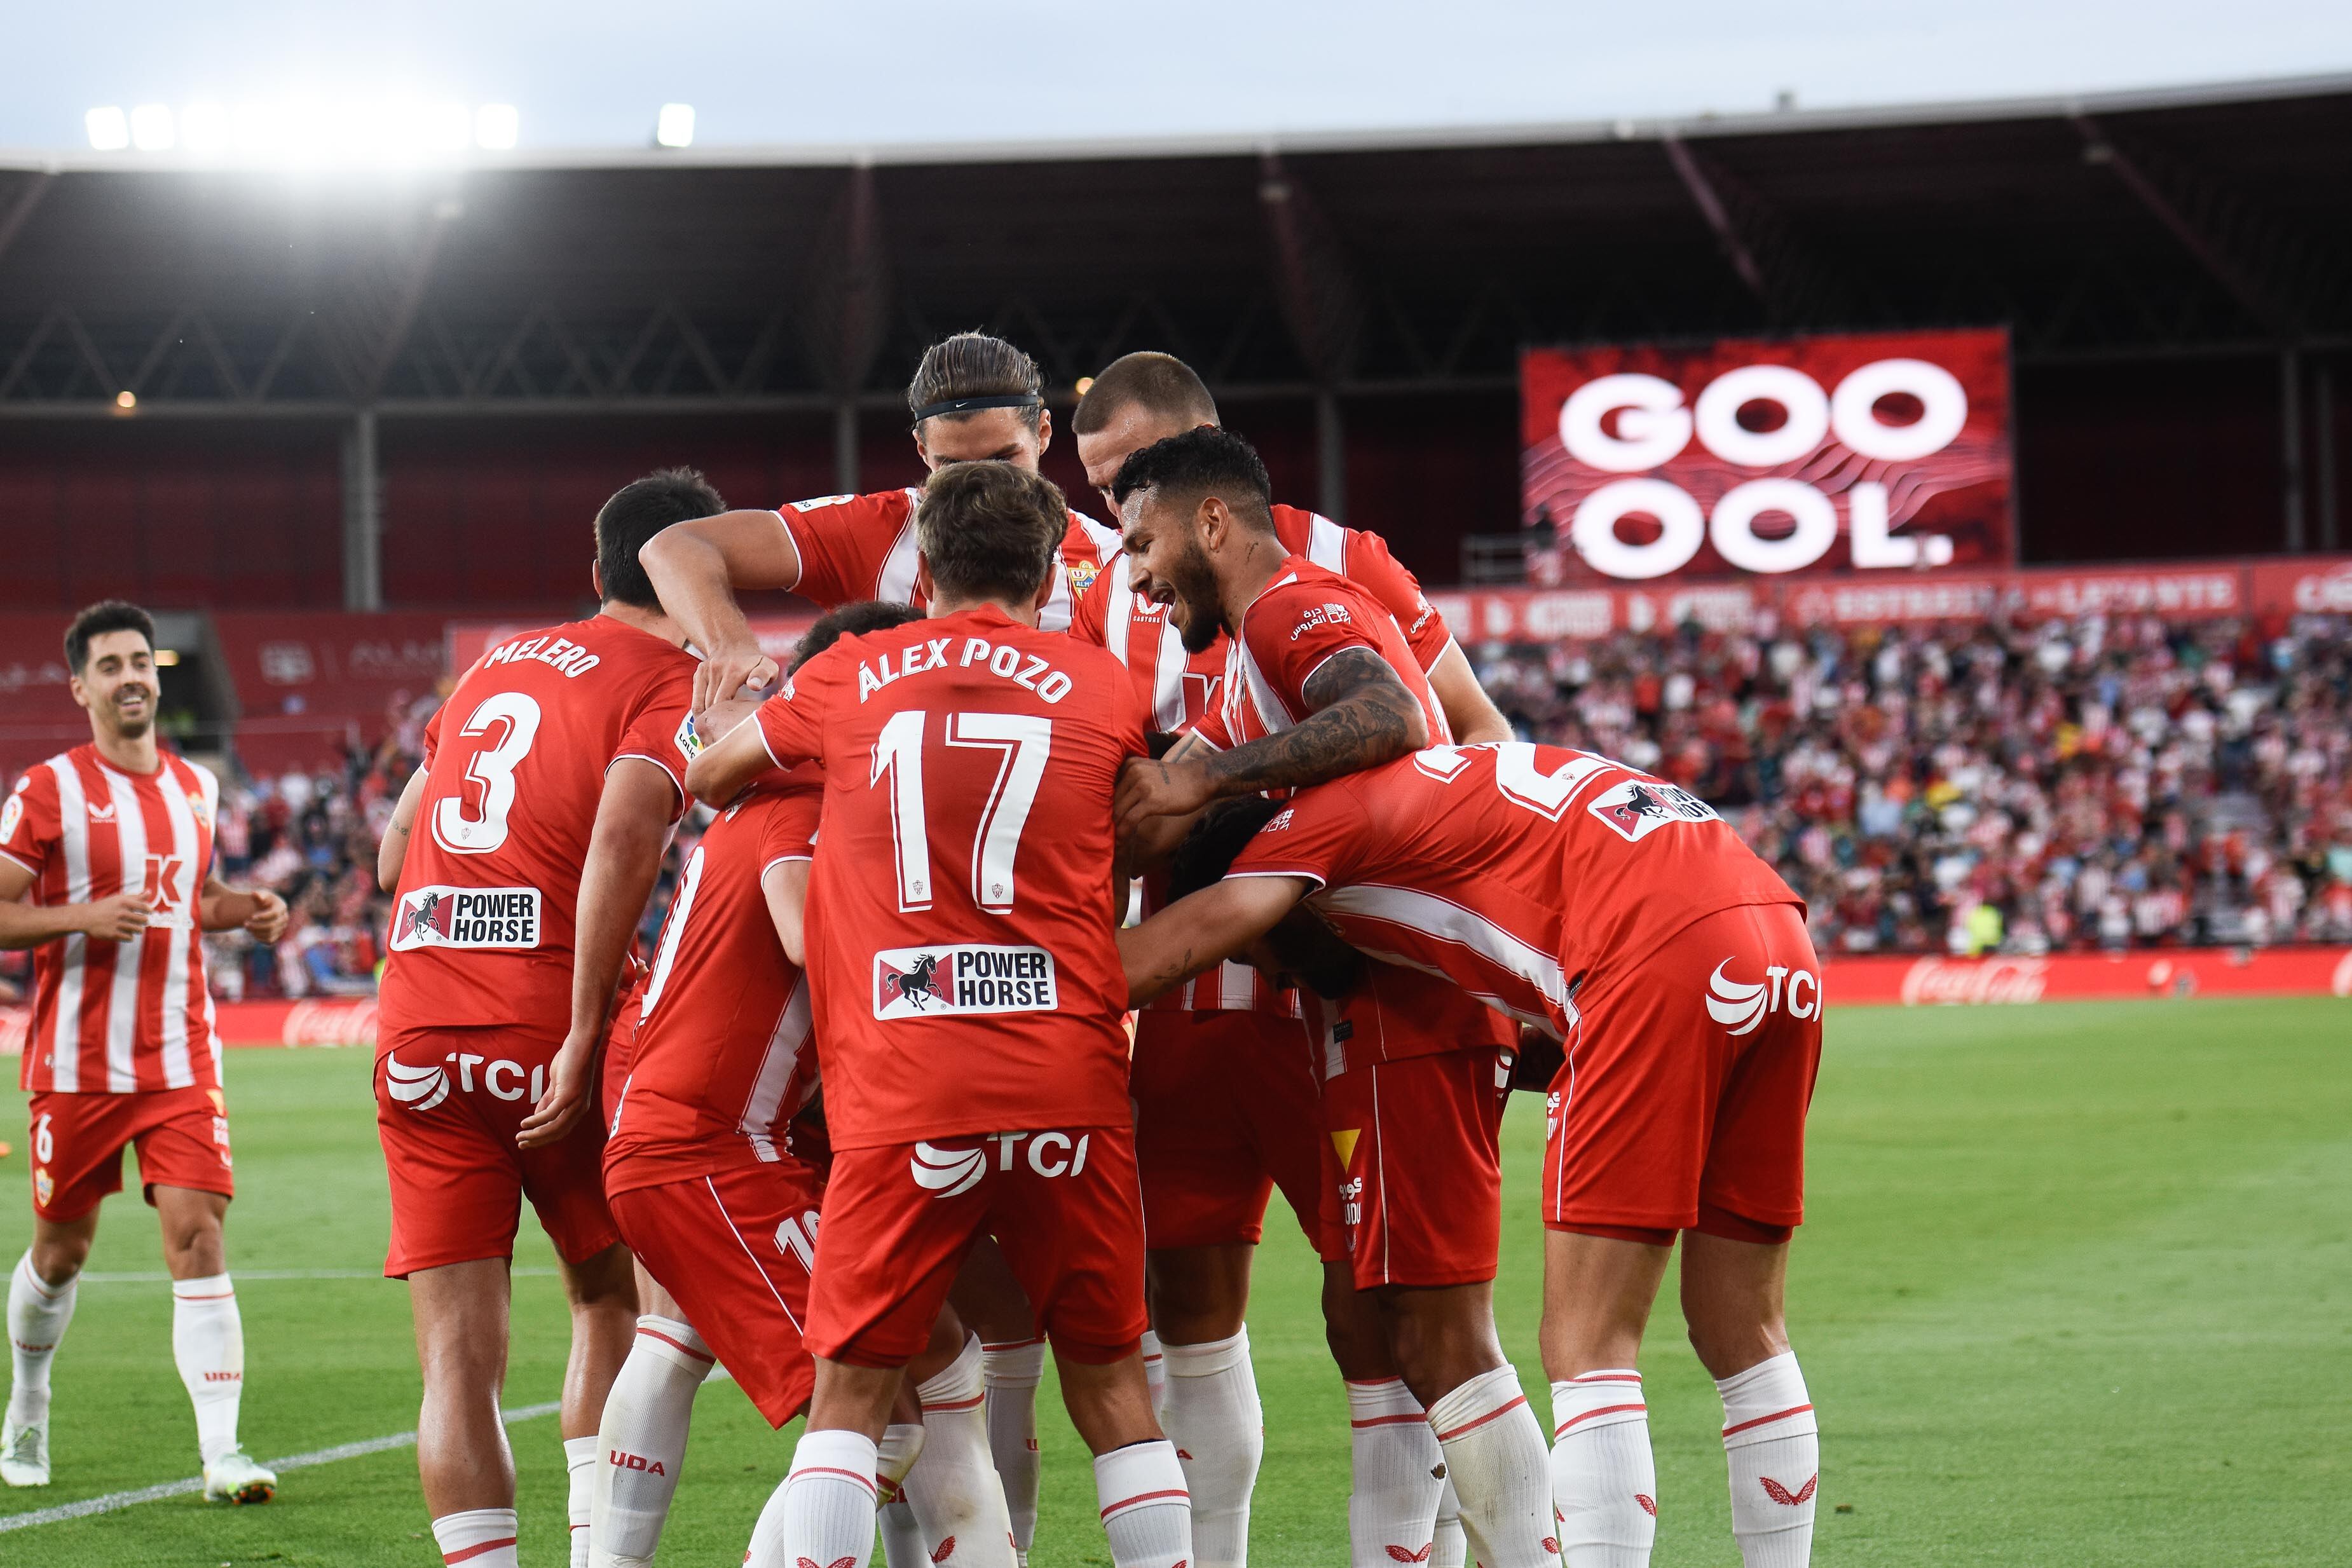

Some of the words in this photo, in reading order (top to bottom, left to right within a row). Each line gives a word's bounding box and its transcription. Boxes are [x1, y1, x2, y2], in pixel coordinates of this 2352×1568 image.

[1558, 358, 1968, 473] GOO
[1571, 477, 1954, 579] OOL.
[1133, 615, 1161, 624] CASTORE
[483, 636, 601, 678] MELERO
[858, 637, 953, 704] ÁLEX
[959, 637, 1072, 704] POZO
[430, 691, 542, 855] 3
[870, 710, 1052, 915] 17
[1669, 801, 1715, 818] HOR
[456, 894, 534, 918] POWER
[453, 919, 534, 942] HORSE
[957, 951, 1048, 979] POWER
[959, 979, 1051, 1007] HORSE
[1766, 965, 1822, 1023] TCI
[445, 1052, 544, 1105] TCI
[36, 1113, 53, 1164] 6
[987, 1131, 1089, 1178] TCI
[610, 1450, 664, 1476] UDA
